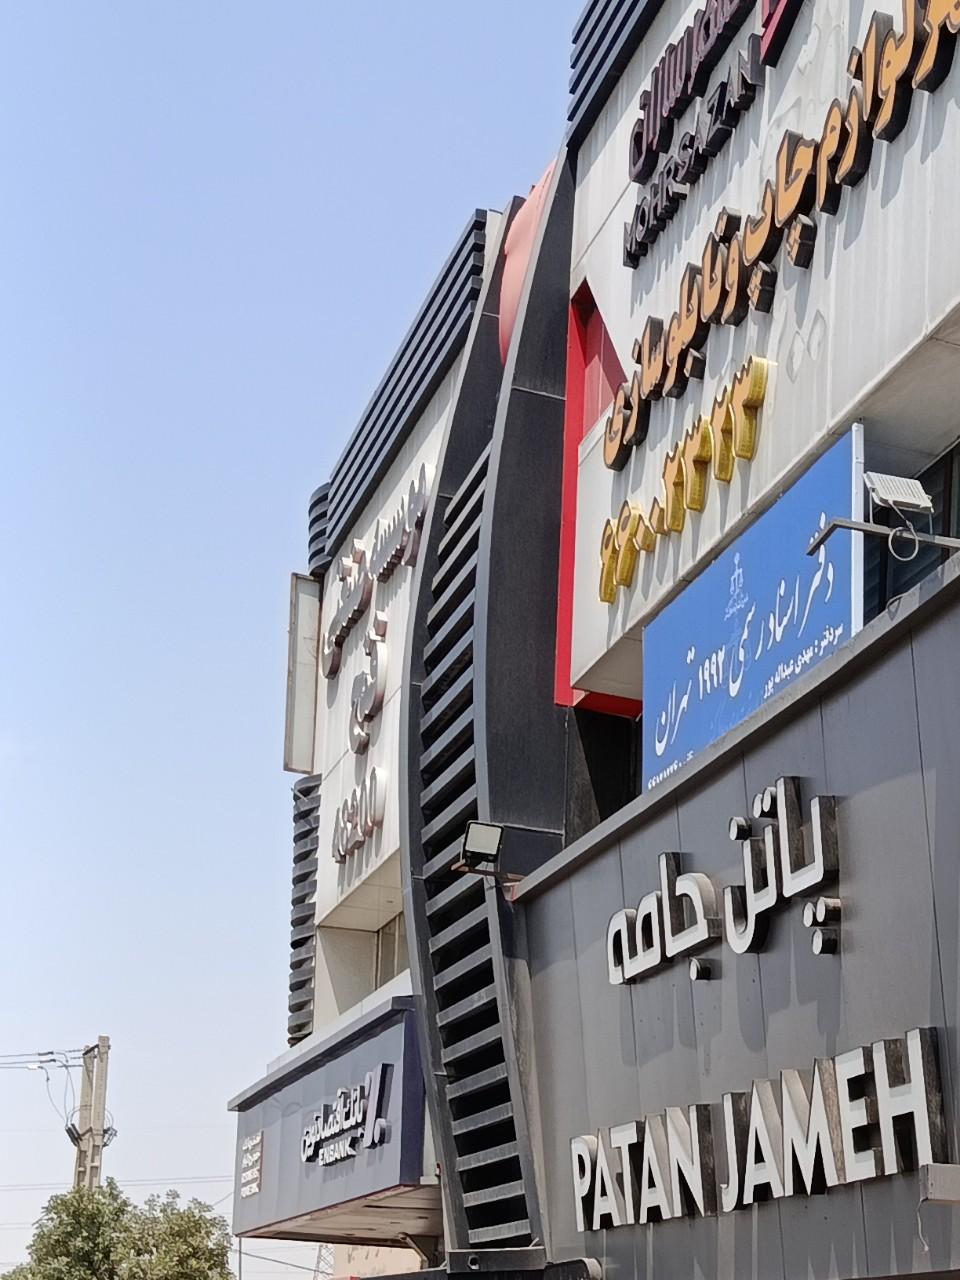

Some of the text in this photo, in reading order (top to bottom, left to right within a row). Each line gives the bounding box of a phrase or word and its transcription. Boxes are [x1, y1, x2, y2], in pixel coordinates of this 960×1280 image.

[655, 645, 696, 757] تهران
[698, 644, 726, 701] ۱۹۹۲
[606, 851, 718, 985] جامه
[570, 1027, 936, 1232] PATAN JAMEH
